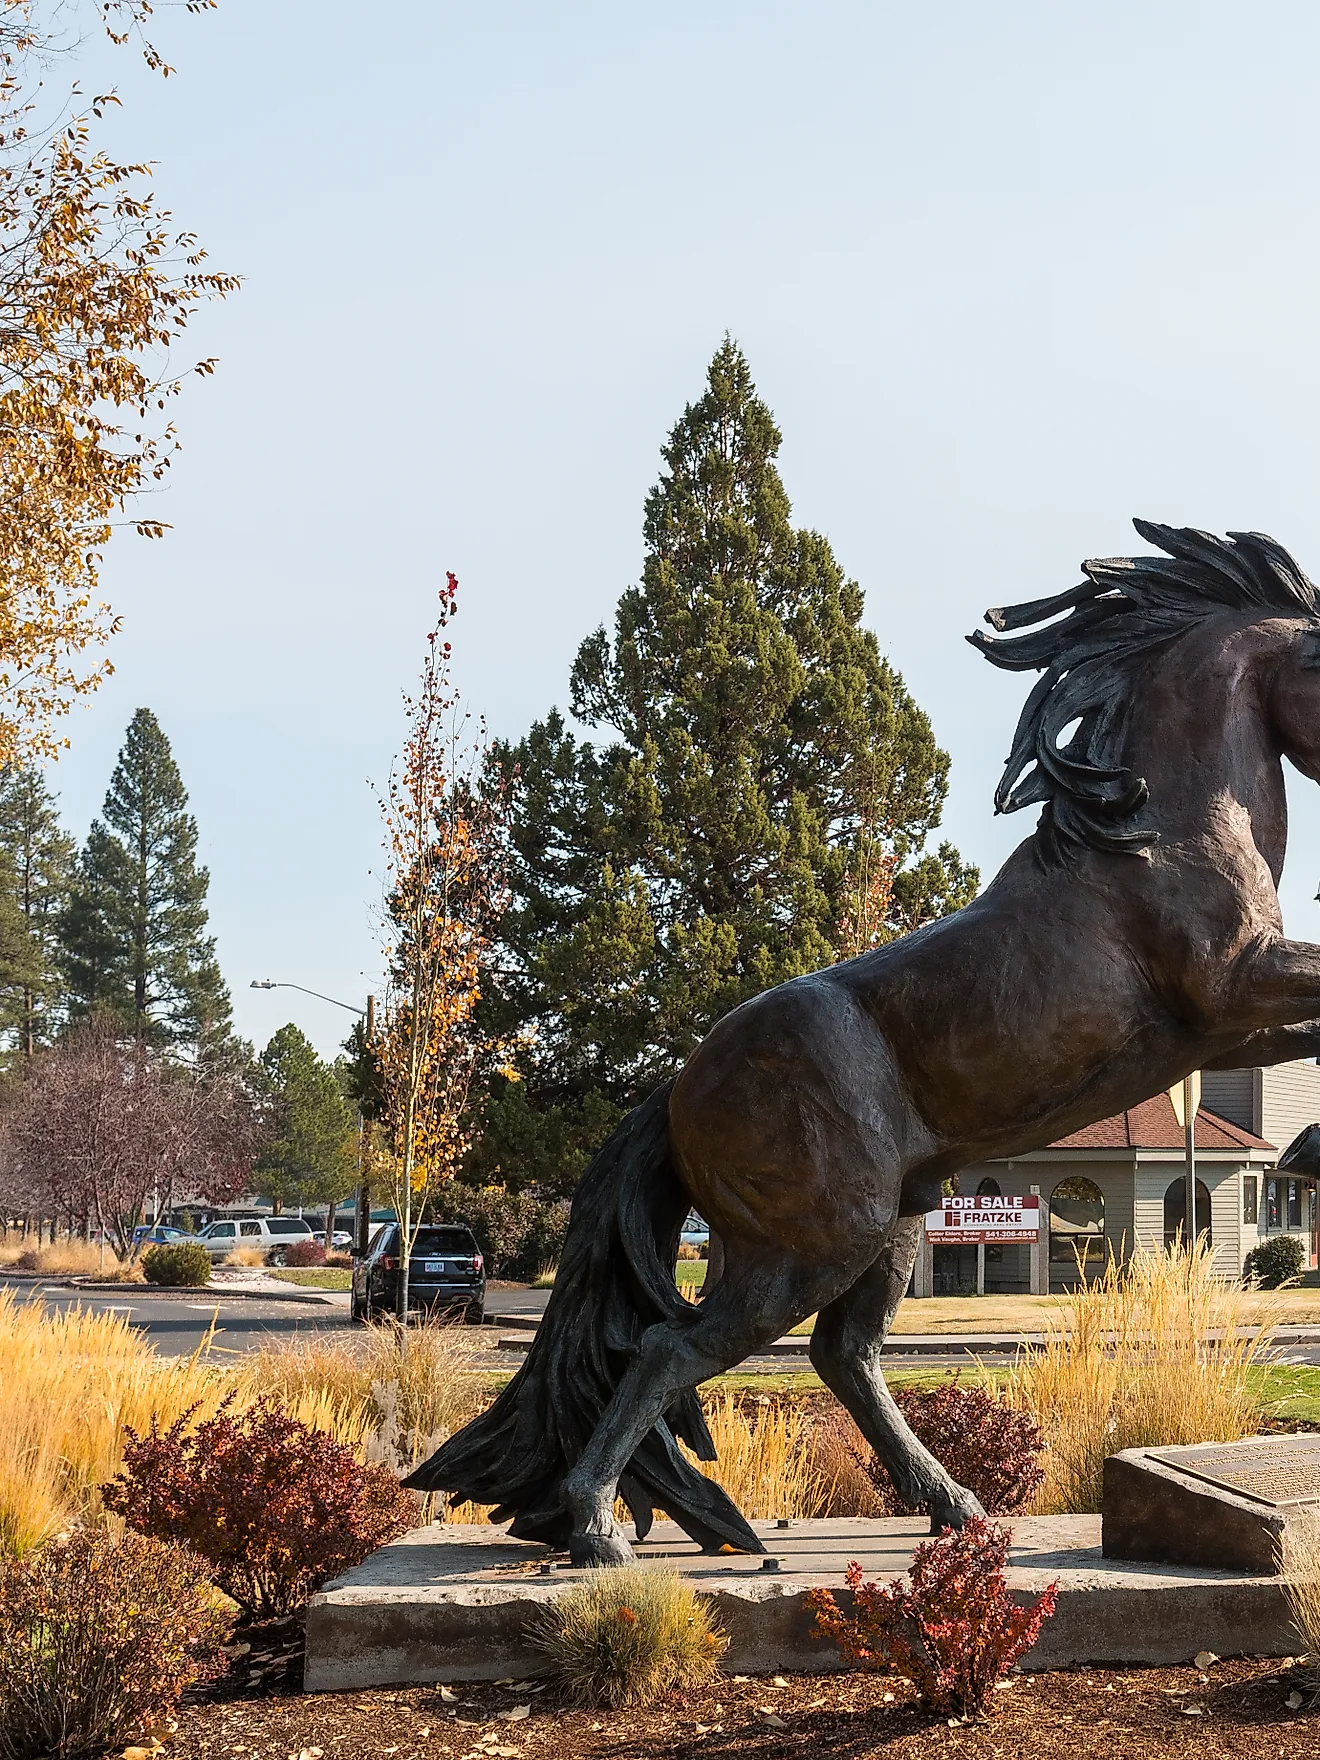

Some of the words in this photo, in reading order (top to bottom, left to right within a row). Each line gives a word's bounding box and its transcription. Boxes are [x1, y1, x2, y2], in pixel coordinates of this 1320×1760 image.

[942, 1197, 975, 1209] FOR
[981, 1196, 1023, 1209] SALE
[964, 1212, 1022, 1223] FRATZKE
